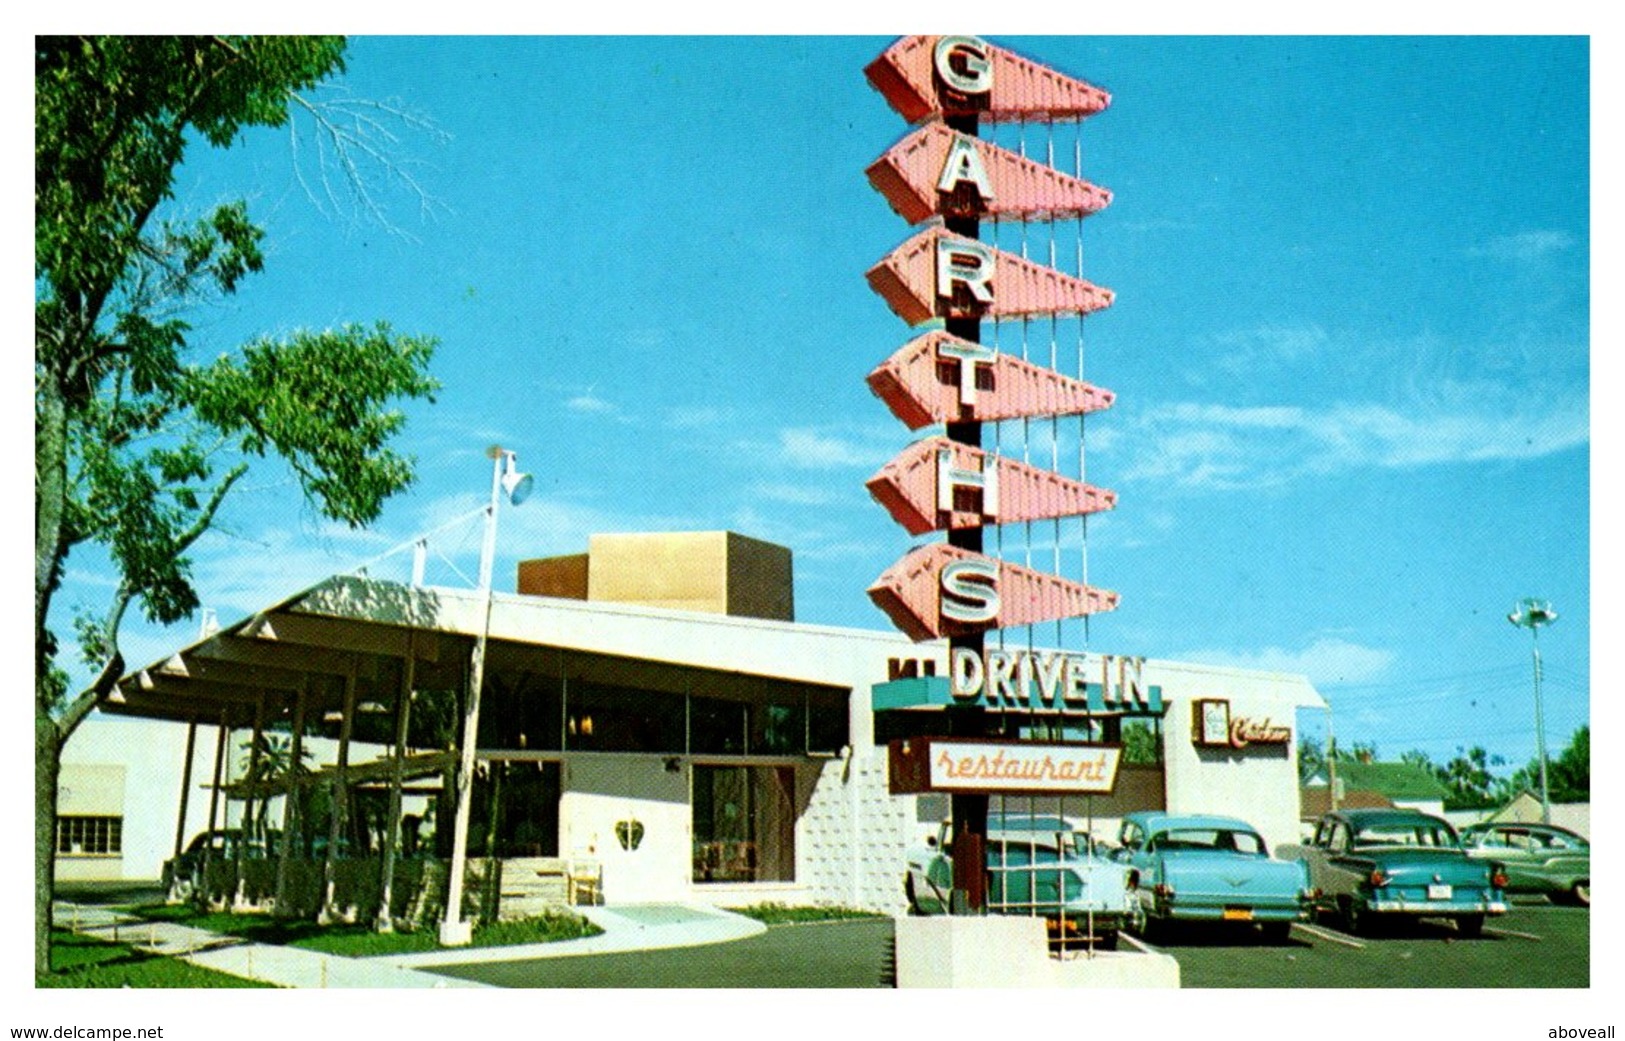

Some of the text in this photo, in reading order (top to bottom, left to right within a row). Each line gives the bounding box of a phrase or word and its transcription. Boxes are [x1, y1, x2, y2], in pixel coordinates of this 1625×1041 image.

[933, 35, 999, 622] GARTHS
[951, 647, 1149, 703] DRIVE IN
[937, 749, 1108, 781] restaurant
